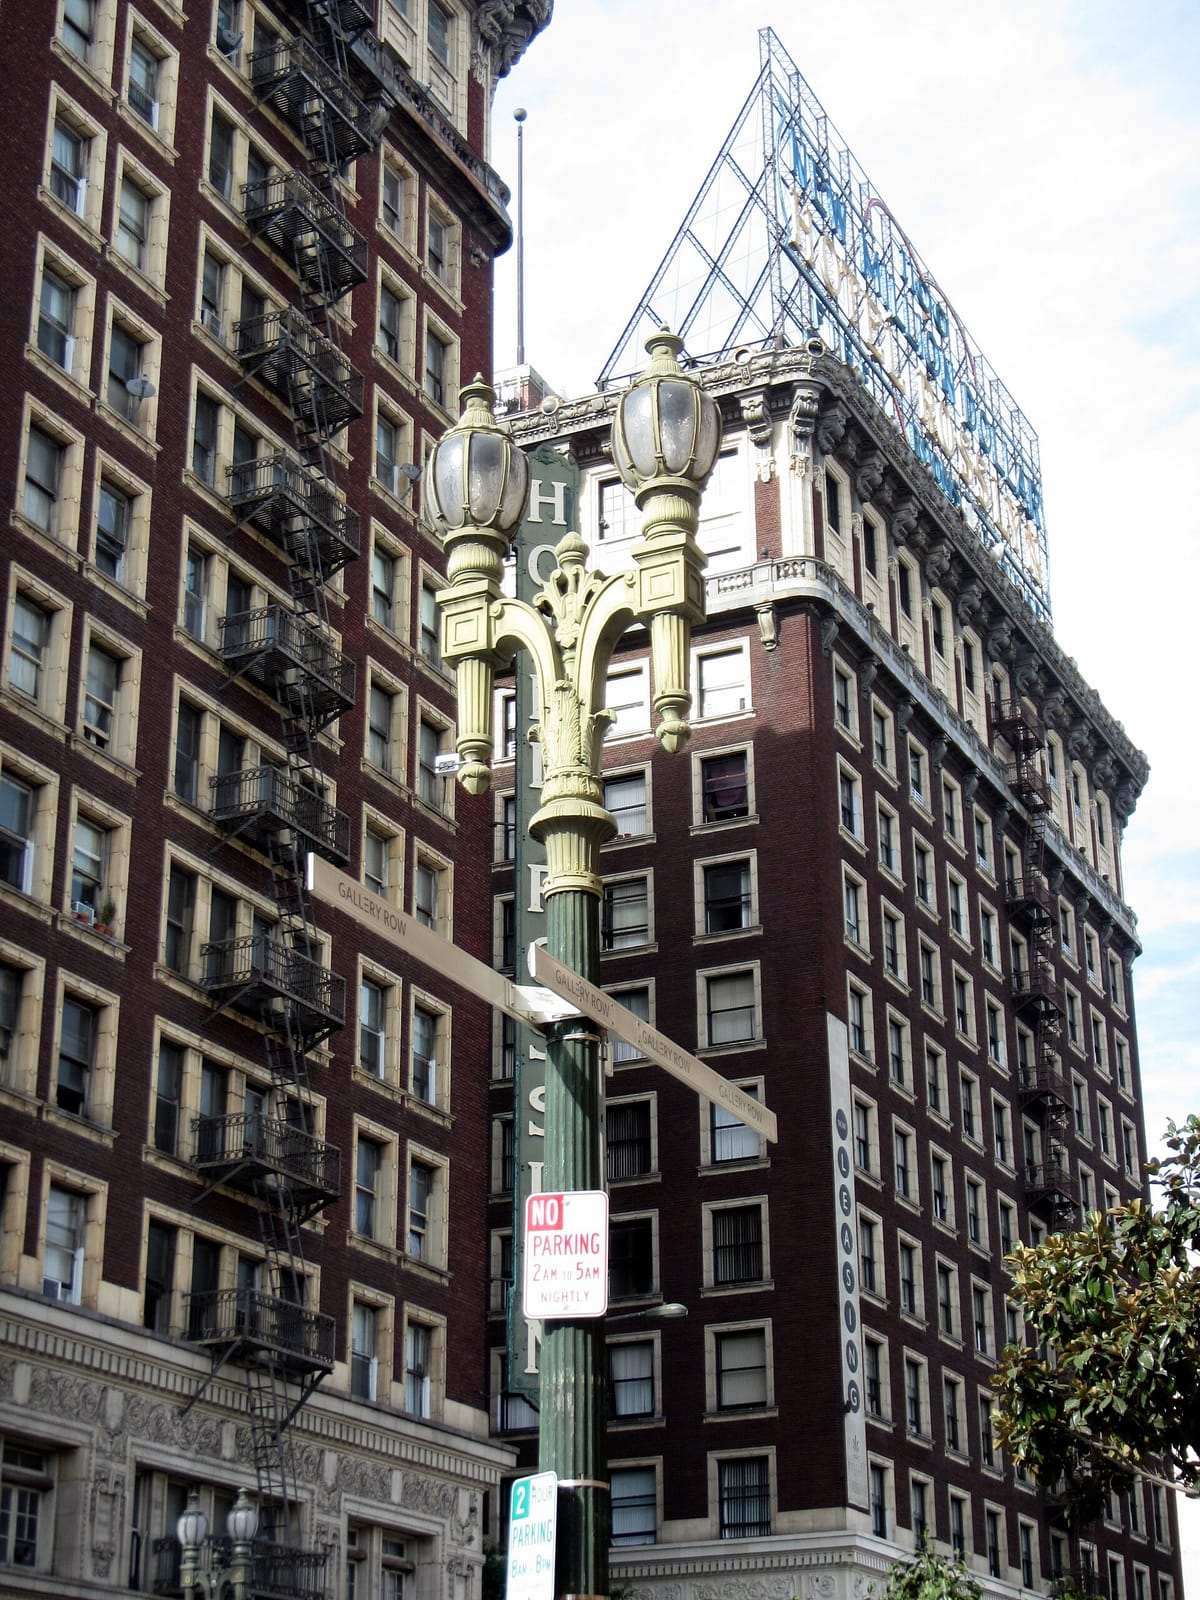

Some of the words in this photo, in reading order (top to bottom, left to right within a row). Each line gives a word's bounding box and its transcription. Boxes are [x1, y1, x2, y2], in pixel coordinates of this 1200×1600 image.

[789, 188, 907, 396] HOTEL
[913, 366, 1044, 589] ROSSLYN
[338, 881, 382, 921] GALLERY
[383, 909, 407, 937] ROW
[555, 969, 589, 1003] GALLERY
[591, 994, 610, 1018] ROW
[641, 1030, 673, 1061] GALLERY
[674, 1054, 691, 1074] ROW
[718, 1085, 747, 1113] GALLERY
[747, 1102, 763, 1123] ROW
[531, 1198, 559, 1227] NO
[533, 1232, 600, 1257] PARKING
[540, 1290, 590, 1303] NIGHTLY
[515, 1486, 526, 1515] 2
[512, 1519, 553, 1548] PARKING
